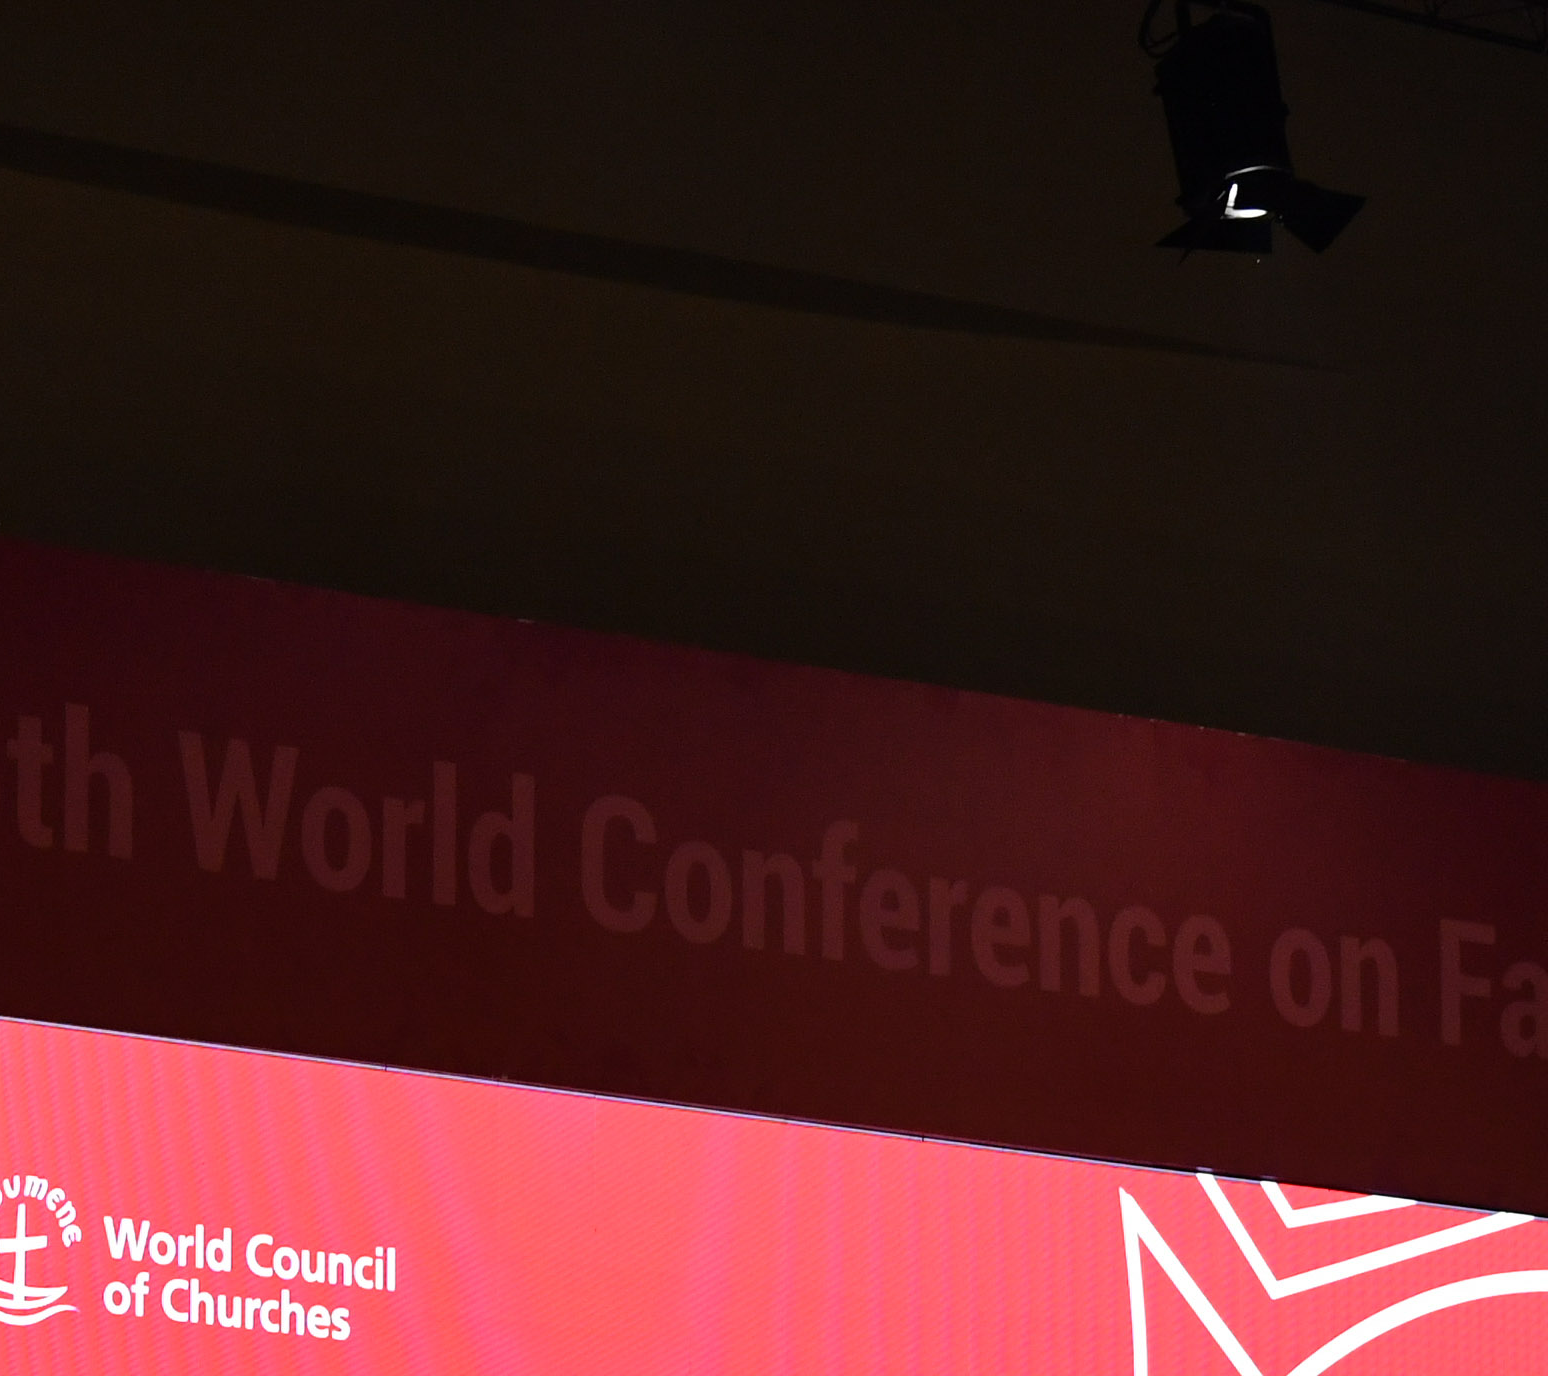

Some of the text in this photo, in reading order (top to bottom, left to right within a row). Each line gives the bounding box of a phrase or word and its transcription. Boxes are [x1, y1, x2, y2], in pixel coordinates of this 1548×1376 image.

[177, 729, 536, 918] World
[581, 794, 1233, 1015] Conference
[1269, 928, 1399, 1037] on
[103, 1215, 396, 1291] World Council
[103, 1272, 351, 1340] of Churches
